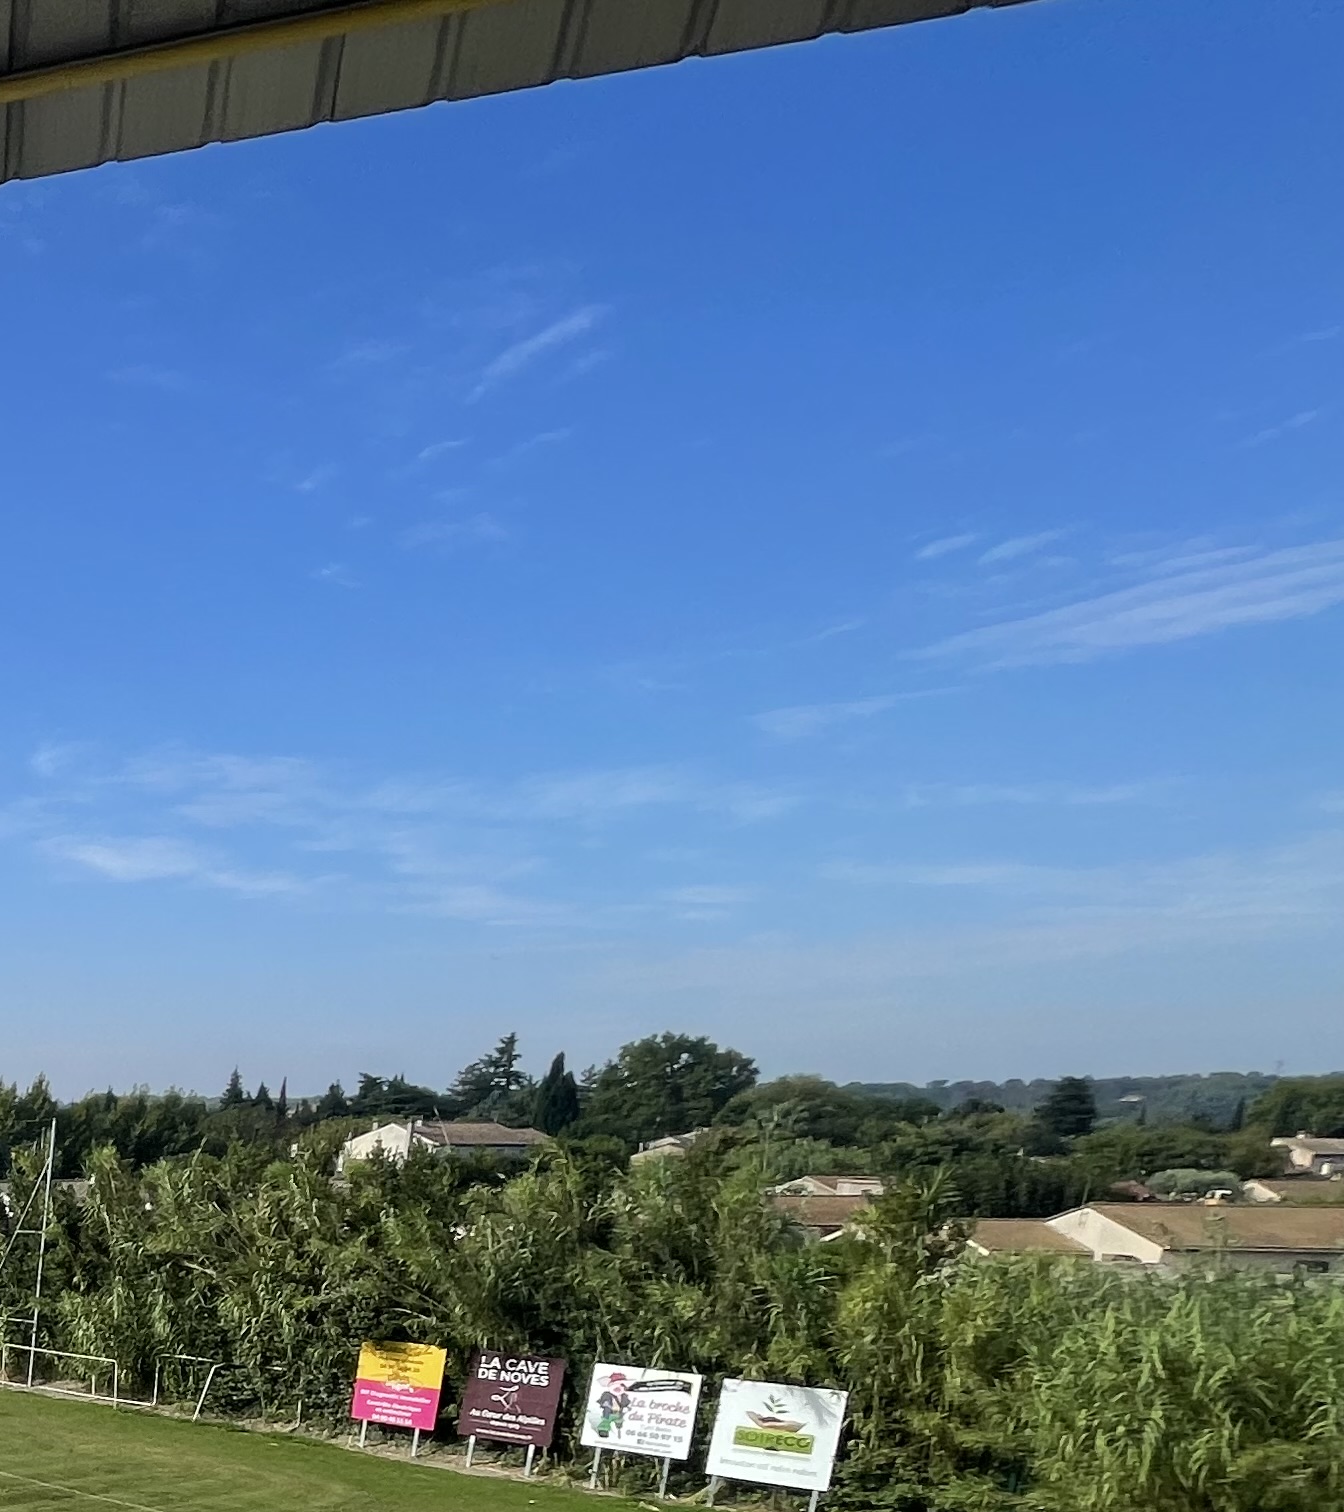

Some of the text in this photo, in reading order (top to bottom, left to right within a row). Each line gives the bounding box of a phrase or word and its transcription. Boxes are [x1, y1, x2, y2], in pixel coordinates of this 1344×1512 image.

[480, 1355, 549, 1375] LA CAVE
[477, 1368, 549, 1387] DE NOVES
[630, 1397, 690, 1414] La broche
[628, 1410, 644, 1421] du
[647, 1412, 687, 1428] Pirate
